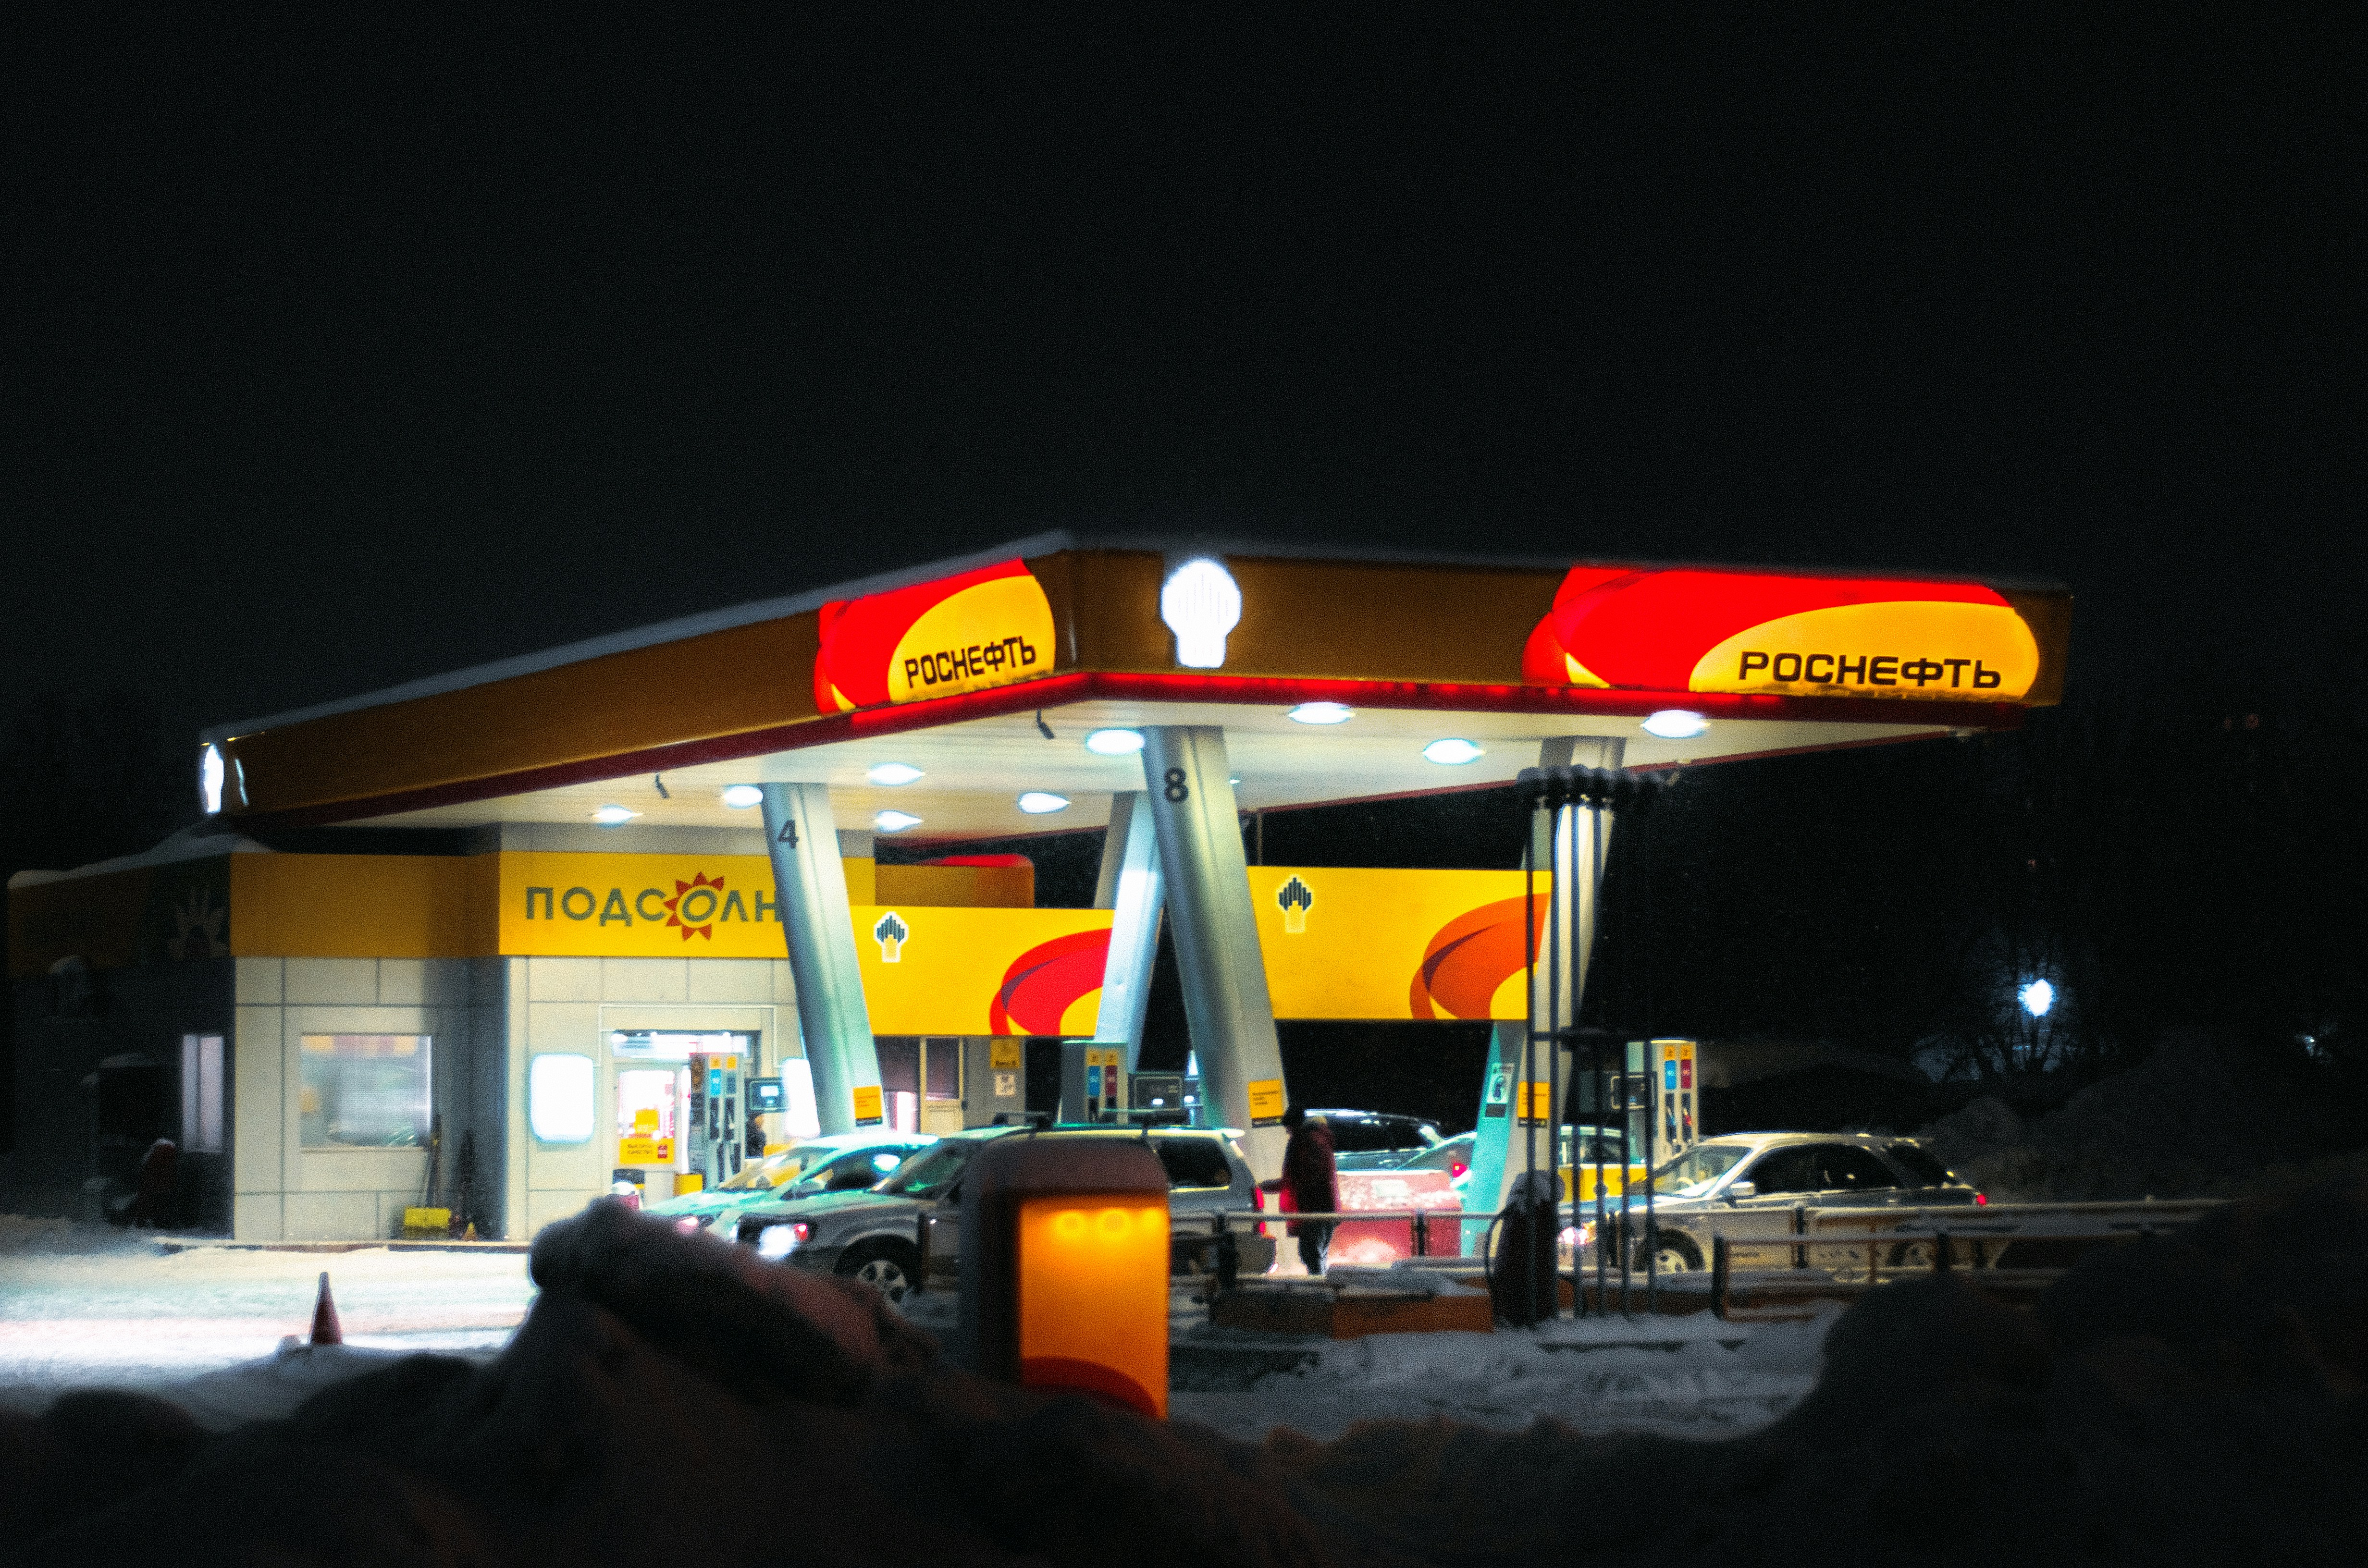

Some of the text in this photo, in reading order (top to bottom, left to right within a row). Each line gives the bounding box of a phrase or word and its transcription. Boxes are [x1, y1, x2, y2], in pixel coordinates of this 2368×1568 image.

[905, 636, 1036, 688] РОСНЕФТЬ
[1739, 651, 2002, 689] РОСНЕФТЬ
[1164, 768, 1188, 802] 8
[777, 820, 799, 849] 4
